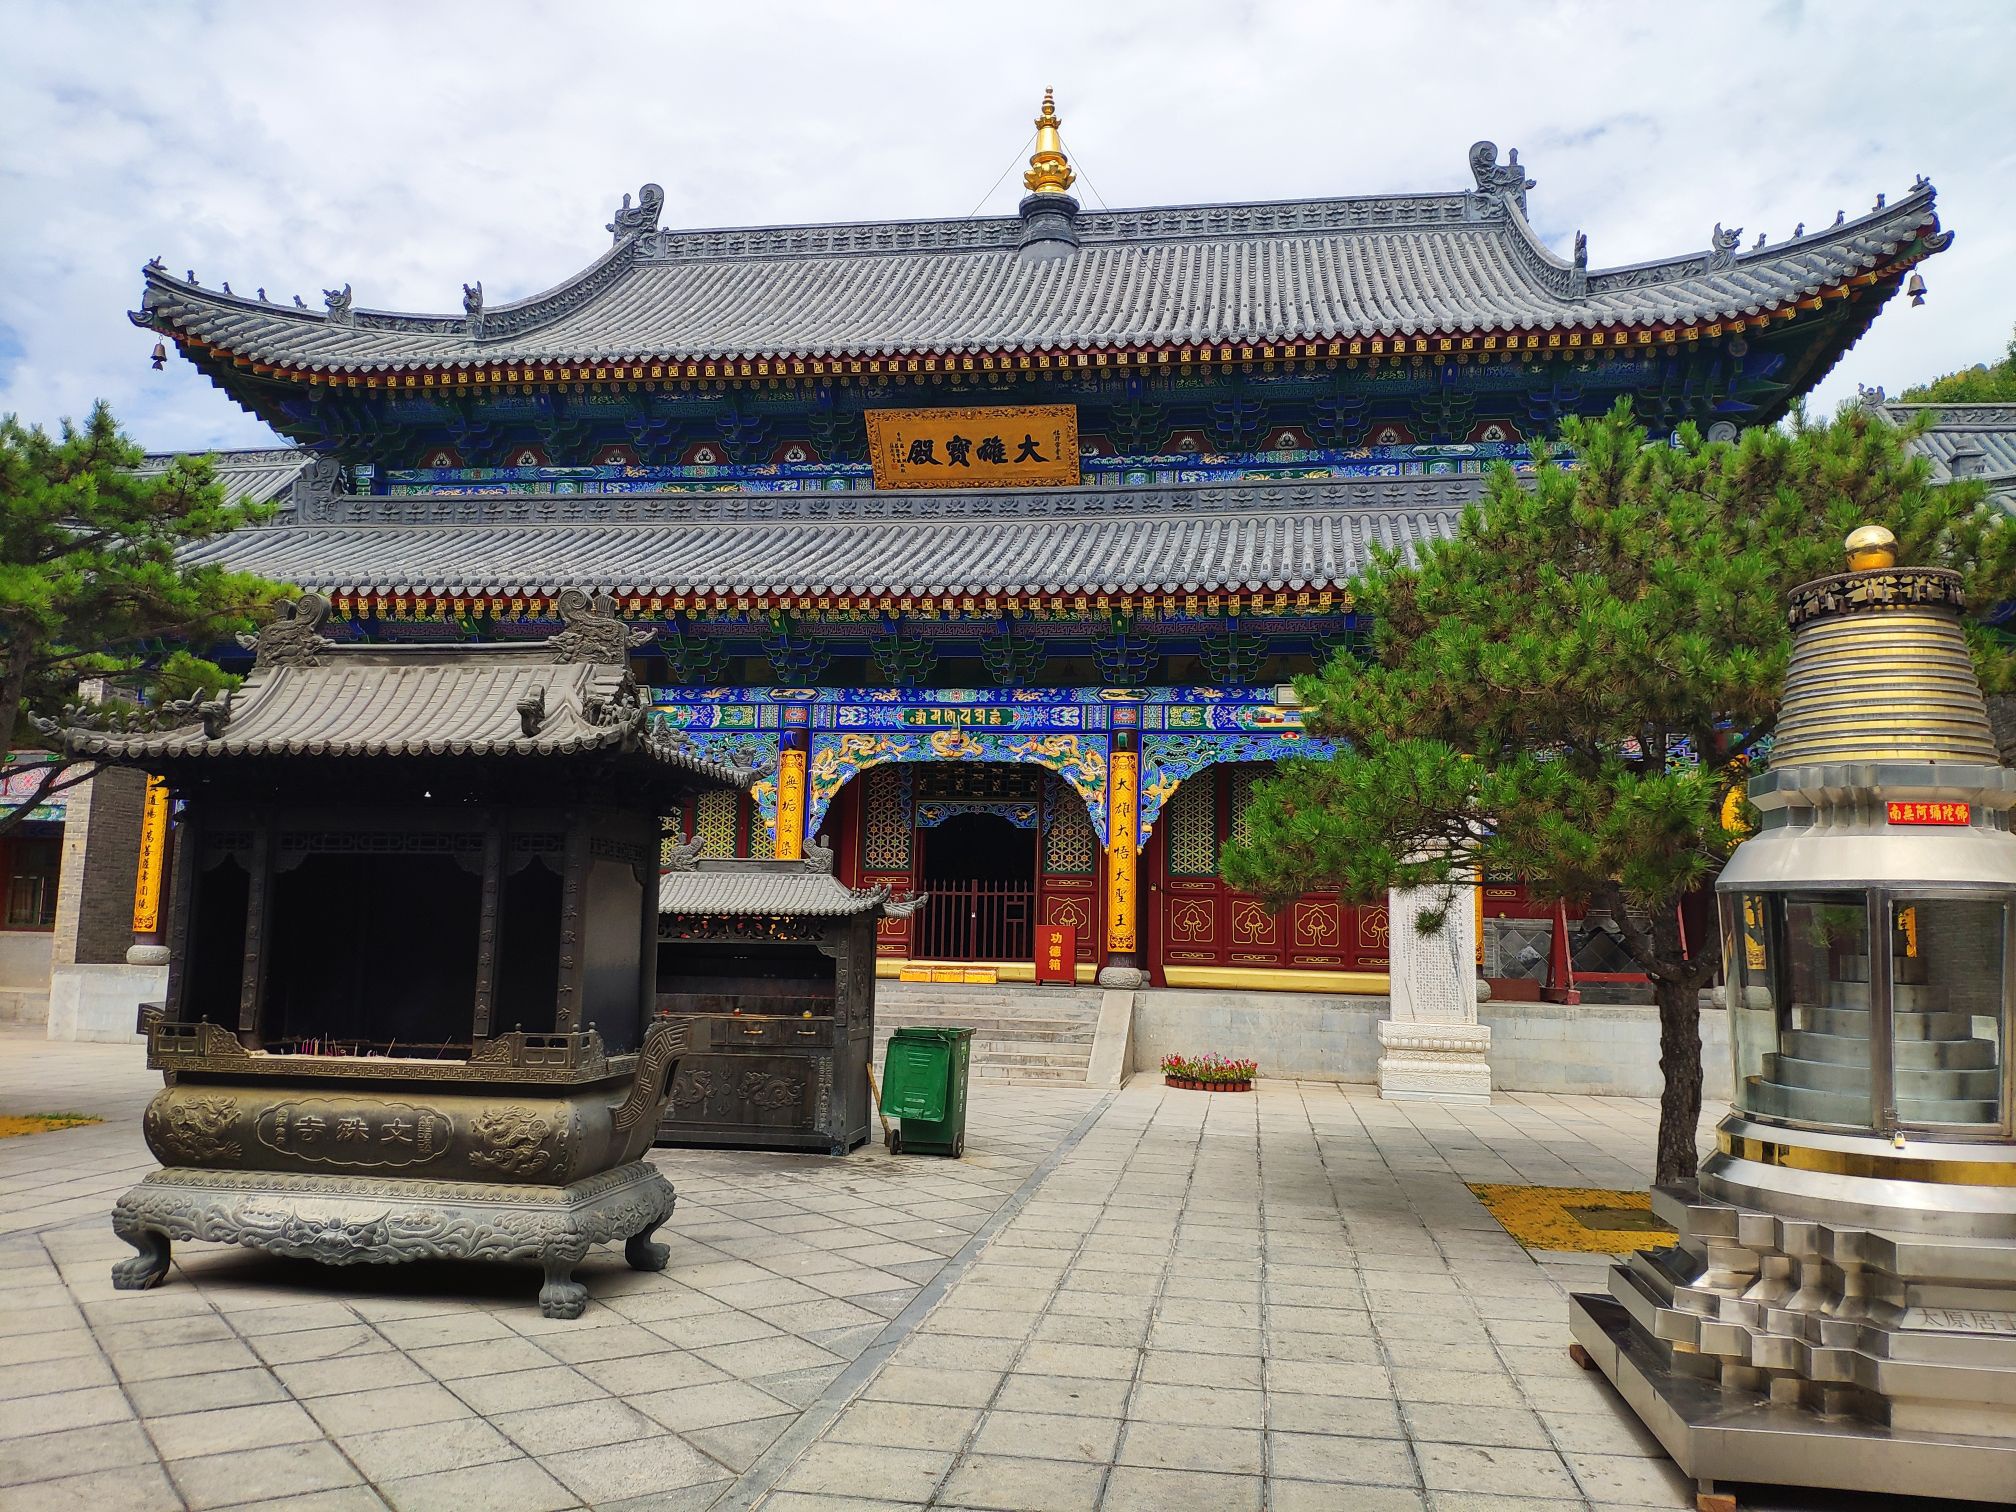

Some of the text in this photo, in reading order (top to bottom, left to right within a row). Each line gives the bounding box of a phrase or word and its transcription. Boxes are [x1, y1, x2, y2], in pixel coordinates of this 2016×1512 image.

[1048, 931, 1063, 971] 功德箱
[293, 1115, 414, 1146] 文殊寺
